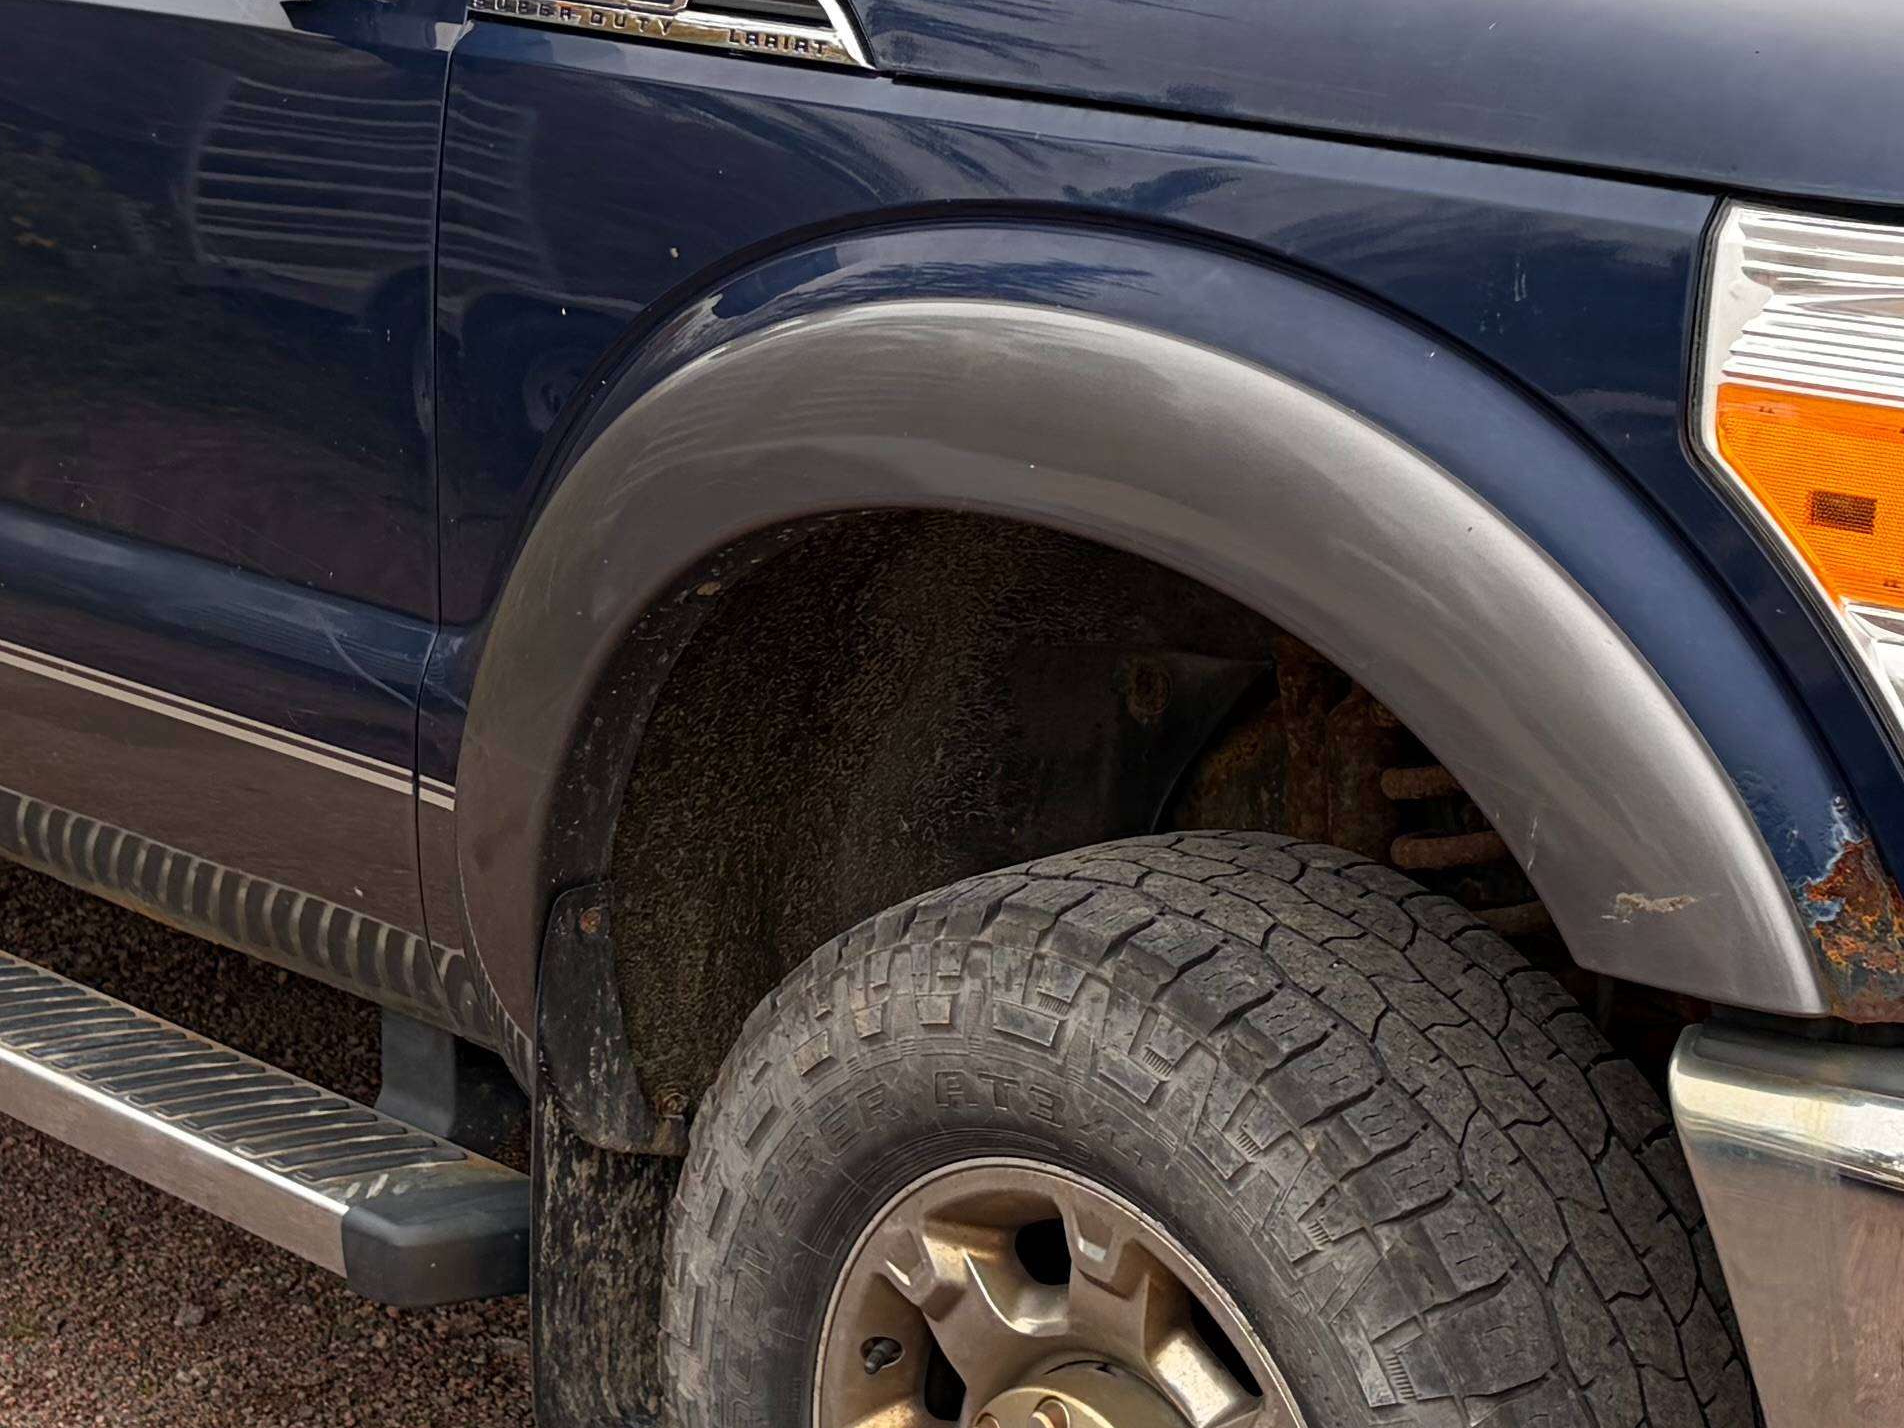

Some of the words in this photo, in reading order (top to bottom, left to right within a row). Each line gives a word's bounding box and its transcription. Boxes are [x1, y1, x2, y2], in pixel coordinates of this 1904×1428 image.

[589, 9, 673, 36] DUTY
[727, 28, 828, 57] LARIAT
[932, 1068, 1066, 1130] AT3
